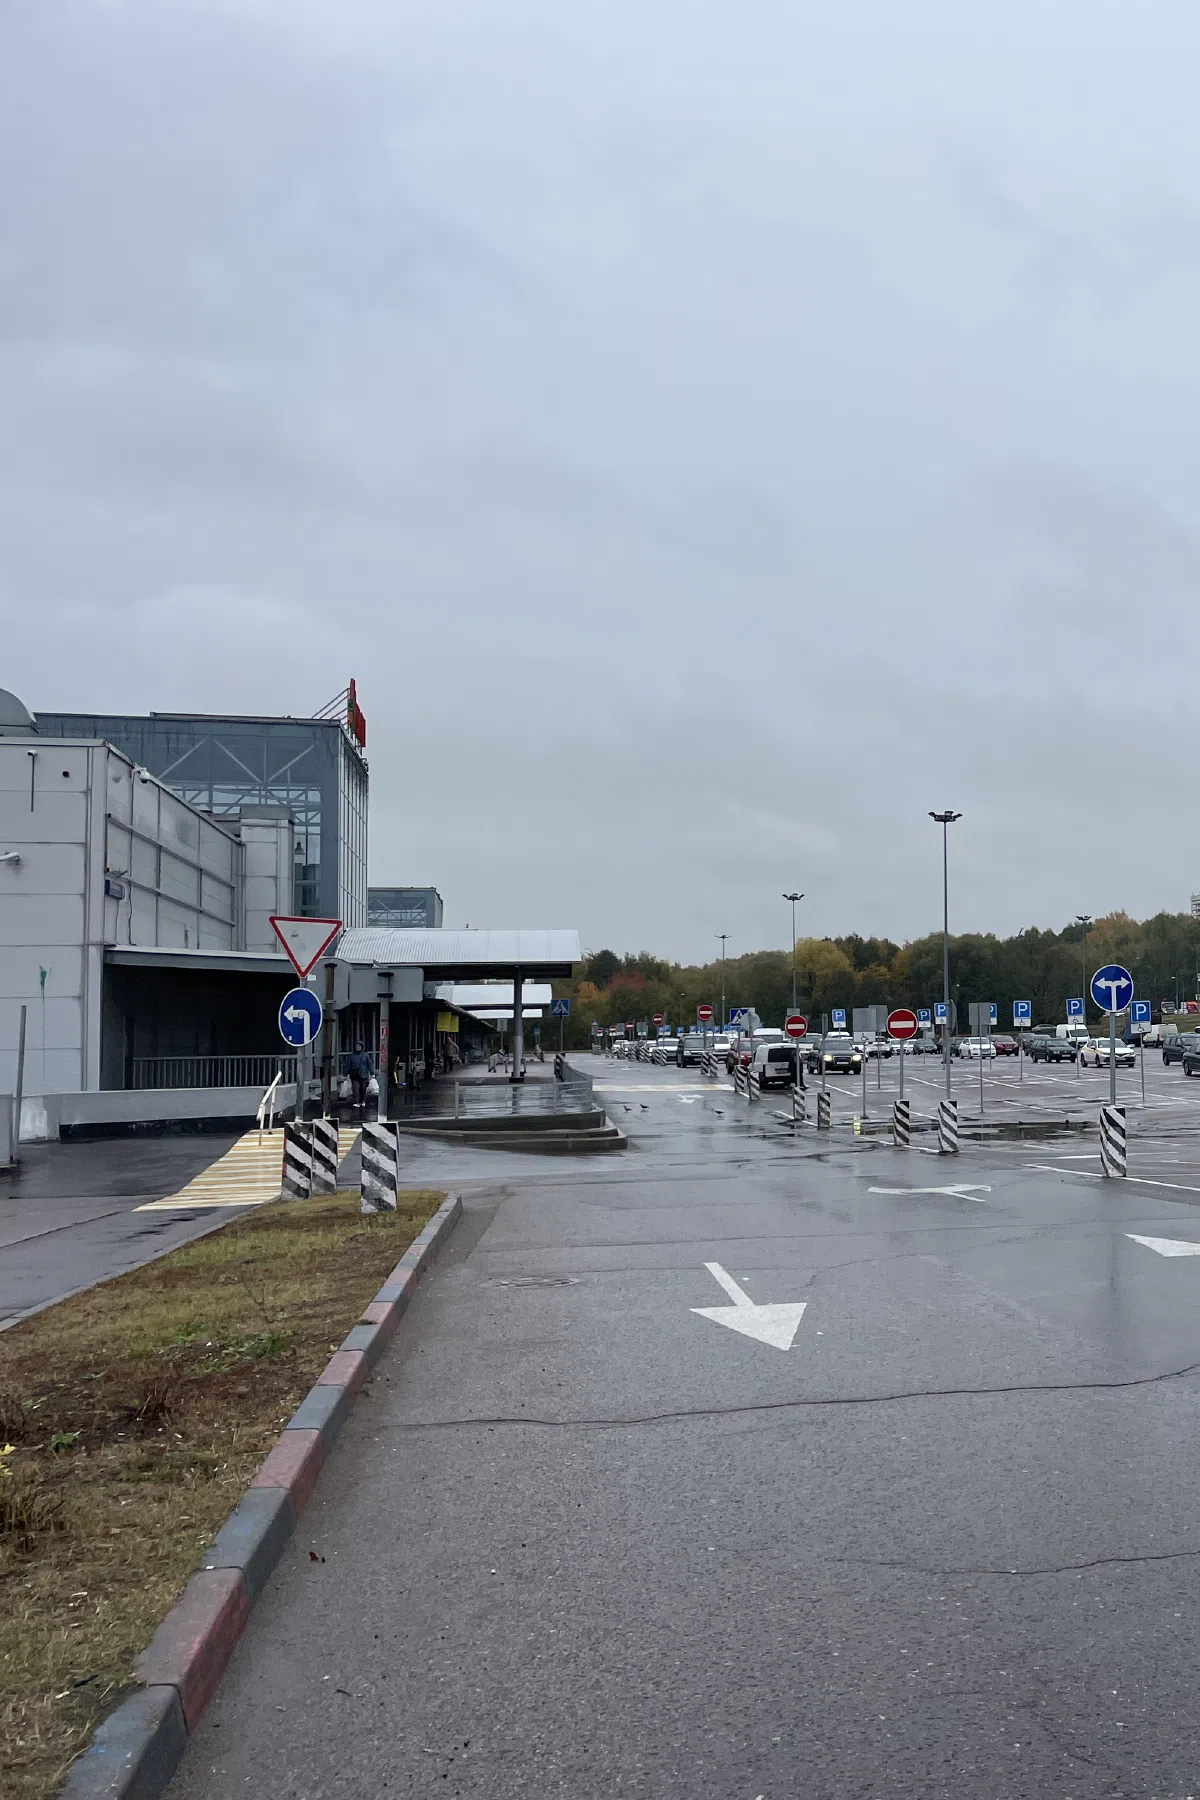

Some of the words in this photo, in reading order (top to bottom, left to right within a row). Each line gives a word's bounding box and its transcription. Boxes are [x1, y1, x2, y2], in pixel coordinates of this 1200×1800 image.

[937, 1004, 946, 1016] P
[1018, 1003, 1028, 1016] P
[1070, 1000, 1080, 1014] P
[1136, 1003, 1147, 1020] P
[835, 1011, 843, 1020] P
[920, 1010, 928, 1020] P
